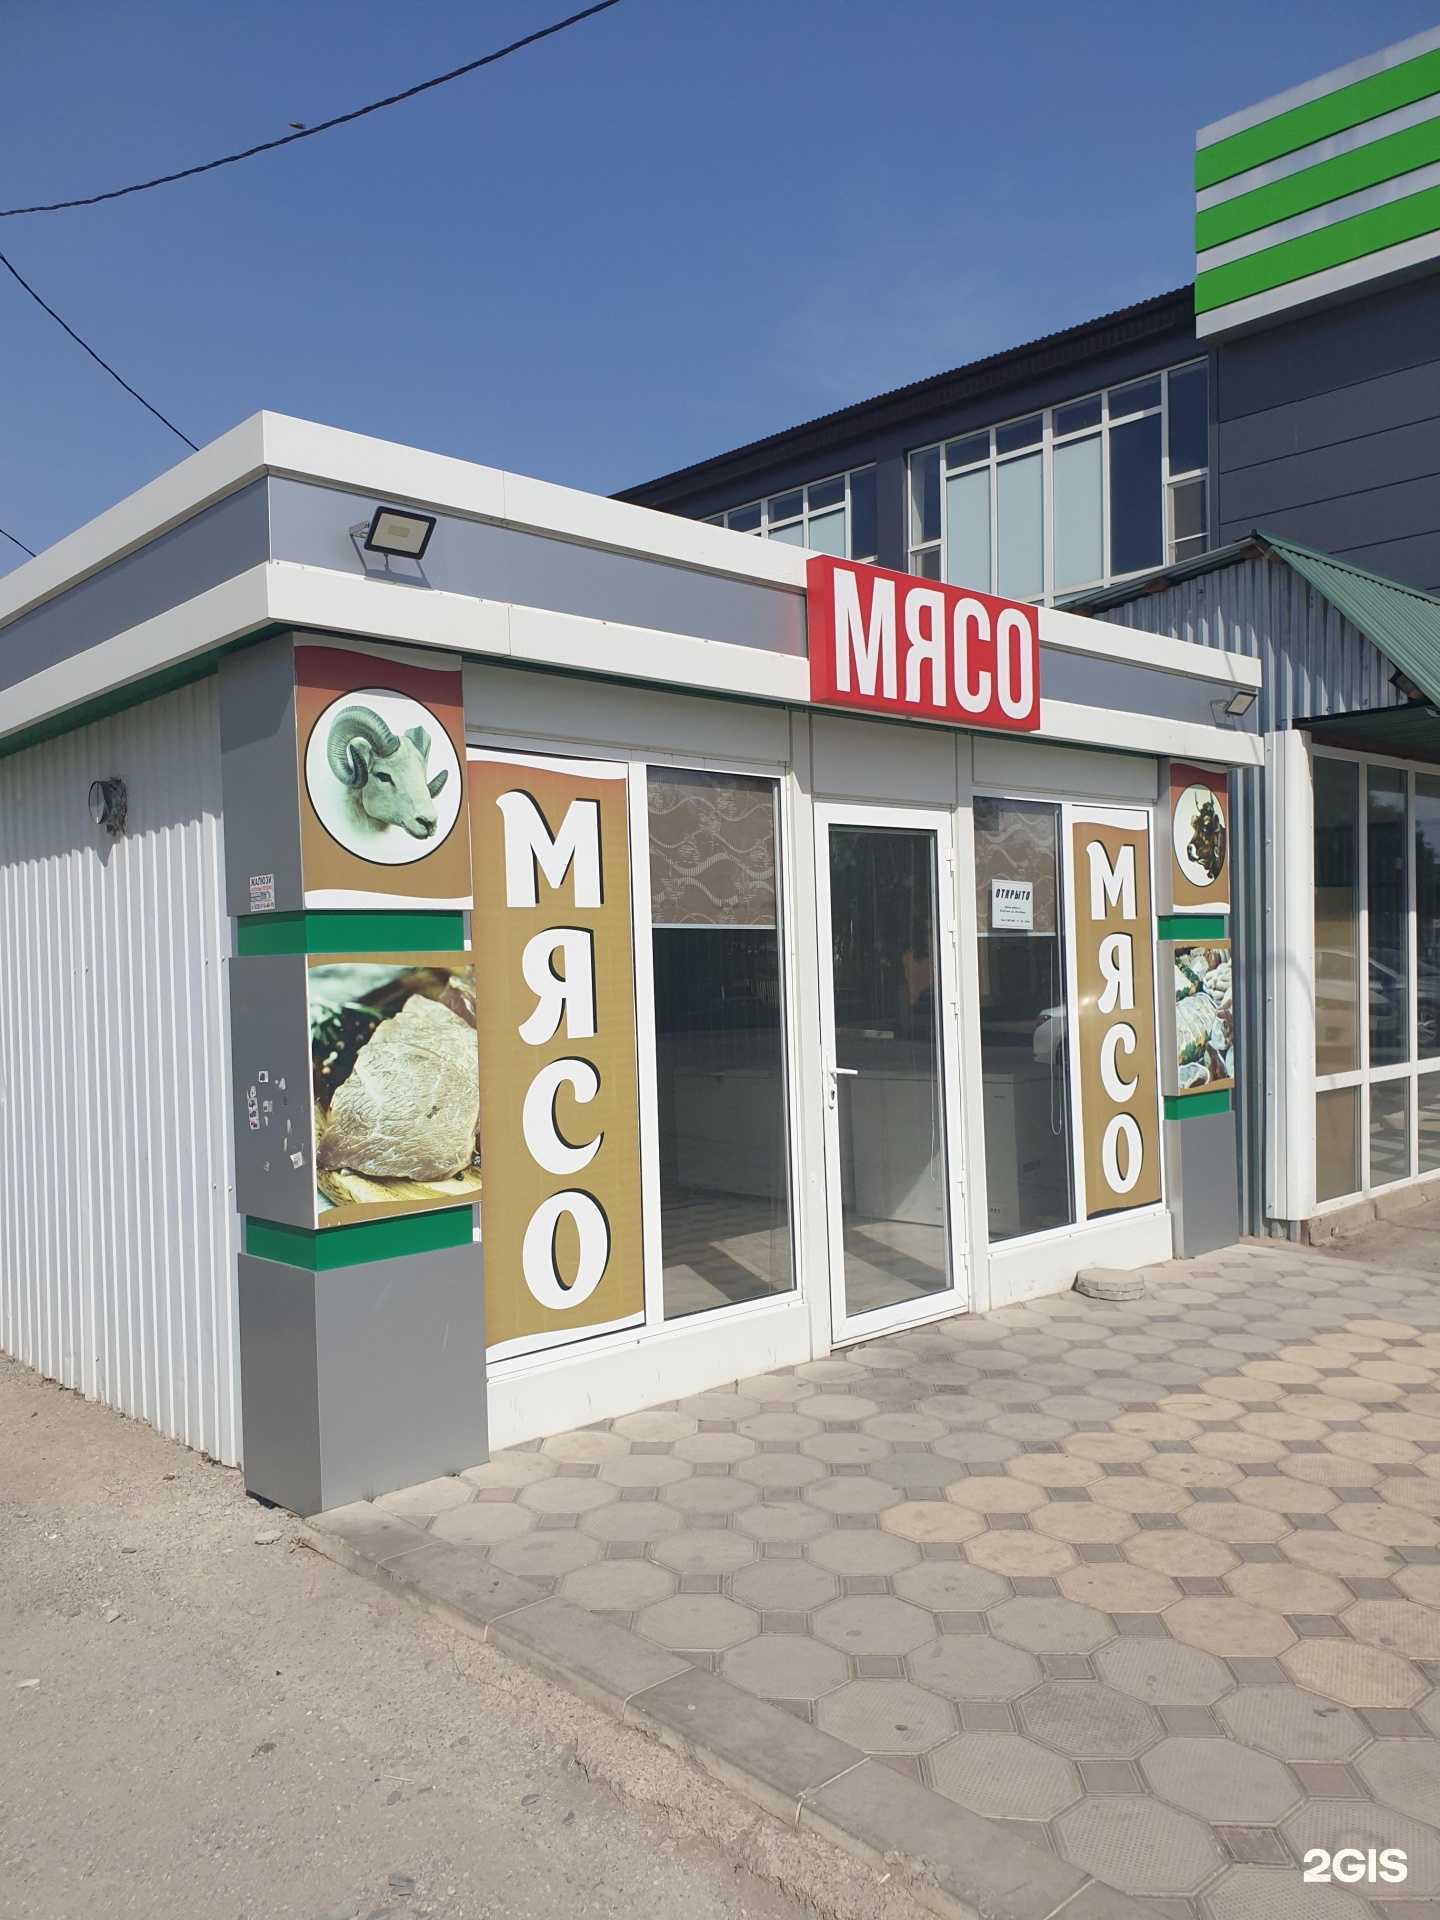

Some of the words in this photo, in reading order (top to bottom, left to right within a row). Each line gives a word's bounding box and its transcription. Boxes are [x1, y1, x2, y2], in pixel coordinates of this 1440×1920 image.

[833, 567, 1034, 719] МЯСО
[995, 888, 1031, 901] ОТКРЫТО
[1086, 840, 1144, 1194] МЯСО
[496, 789, 611, 1310] МЯСО
